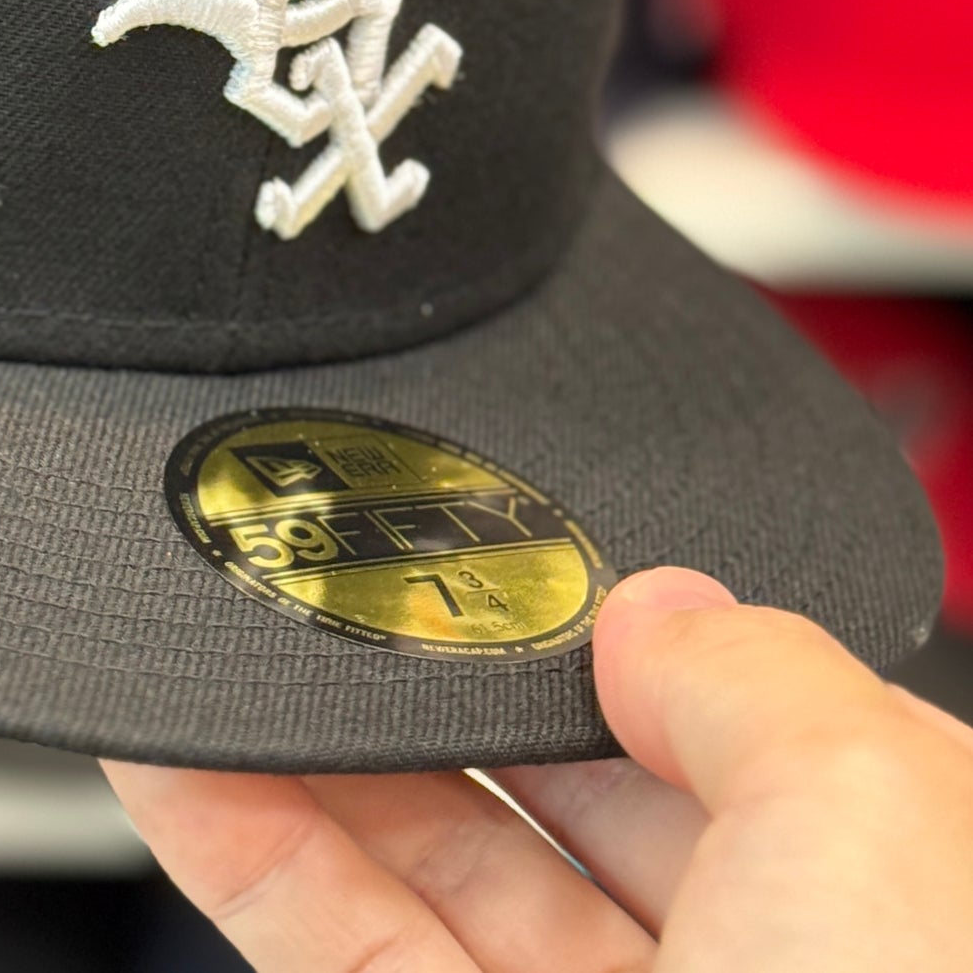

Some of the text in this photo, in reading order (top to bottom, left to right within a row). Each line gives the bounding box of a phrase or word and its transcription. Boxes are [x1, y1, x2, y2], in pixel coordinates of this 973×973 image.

[325, 446, 386, 465] NEW
[340, 459, 402, 477] ERA
[403, 574, 464, 617] 7
